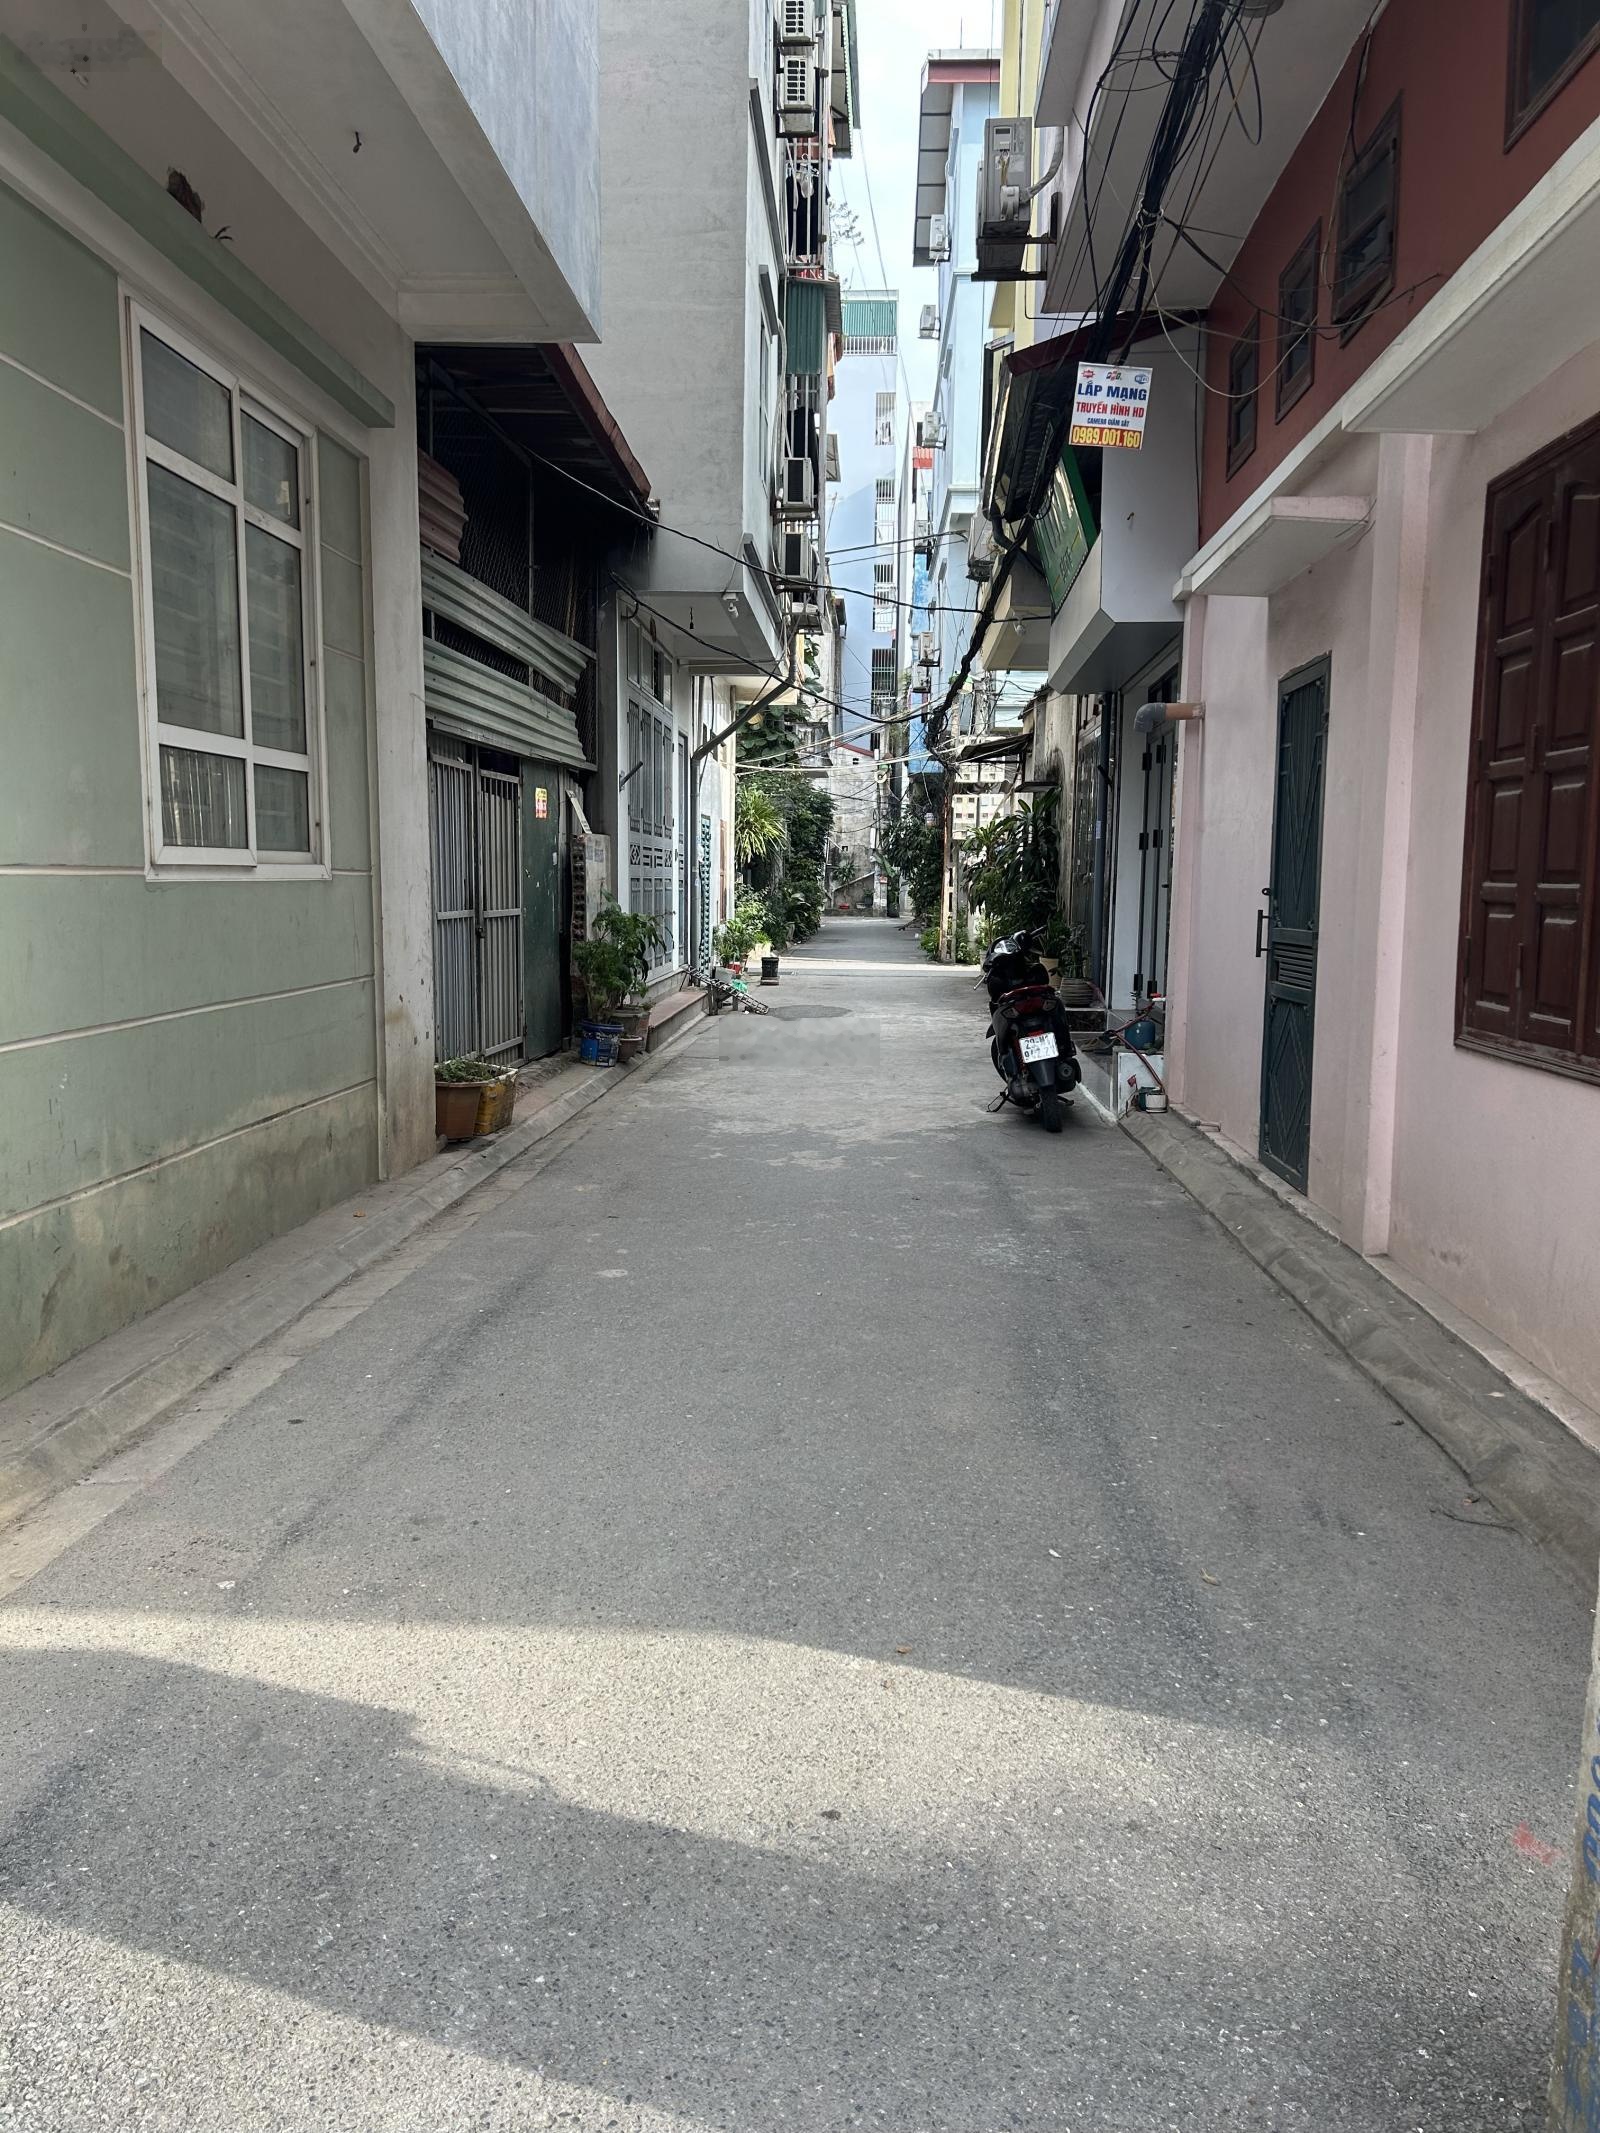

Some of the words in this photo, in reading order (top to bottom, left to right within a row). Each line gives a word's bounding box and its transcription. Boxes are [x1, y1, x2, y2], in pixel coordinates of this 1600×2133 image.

[1077, 380, 1102, 396] LẮP
[1106, 385, 1147, 402] MẠNG
[1110, 402, 1130, 416] HÌNH
[1133, 407, 1144, 418] HD
[1073, 427, 1140, 447] 0989.001.160
